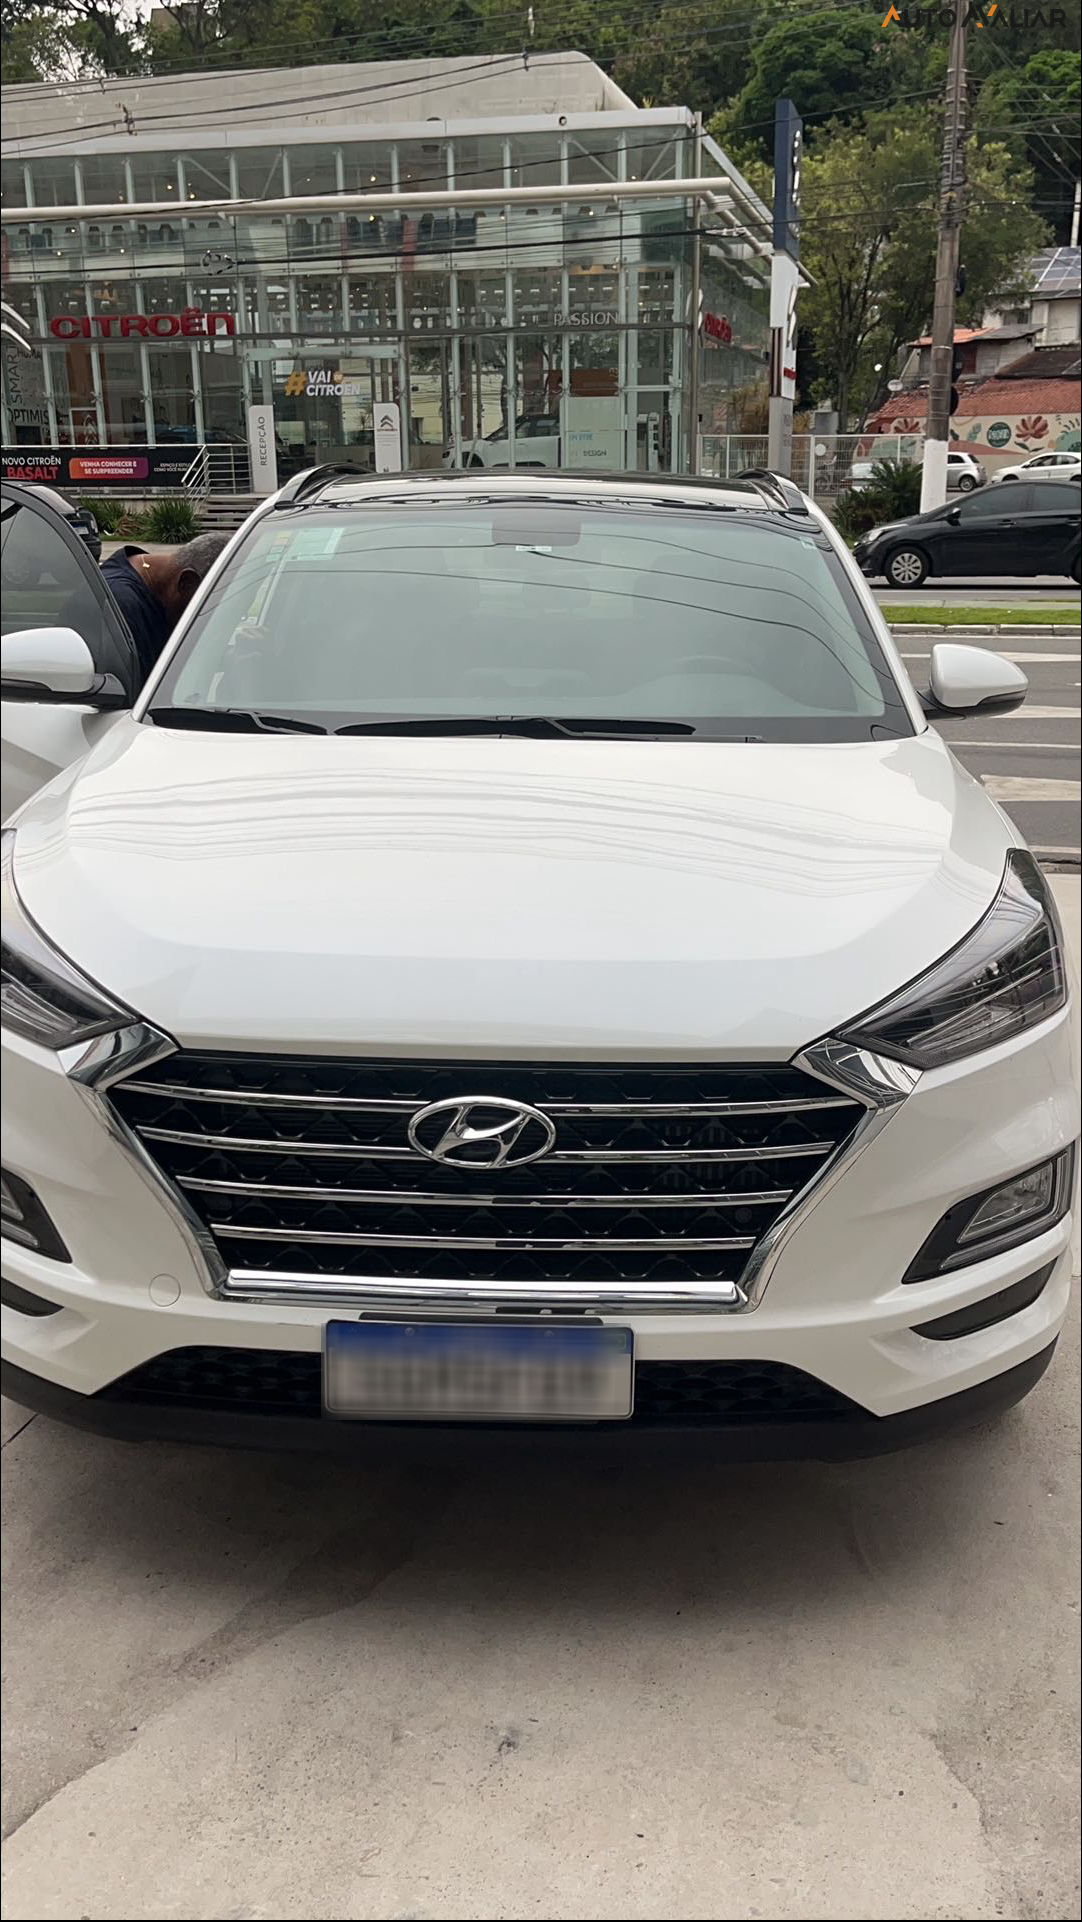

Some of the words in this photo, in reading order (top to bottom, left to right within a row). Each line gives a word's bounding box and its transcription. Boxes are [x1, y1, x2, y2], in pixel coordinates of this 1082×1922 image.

[553, 312, 618, 326] PASSION
[308, 371, 332, 383] VAI
[257, 416, 267, 466] RECEPÇÃO
[1, 457, 26, 465] NOVO
[27, 455, 61, 465] CITROËN
[7, 466, 58, 480] BASALT
